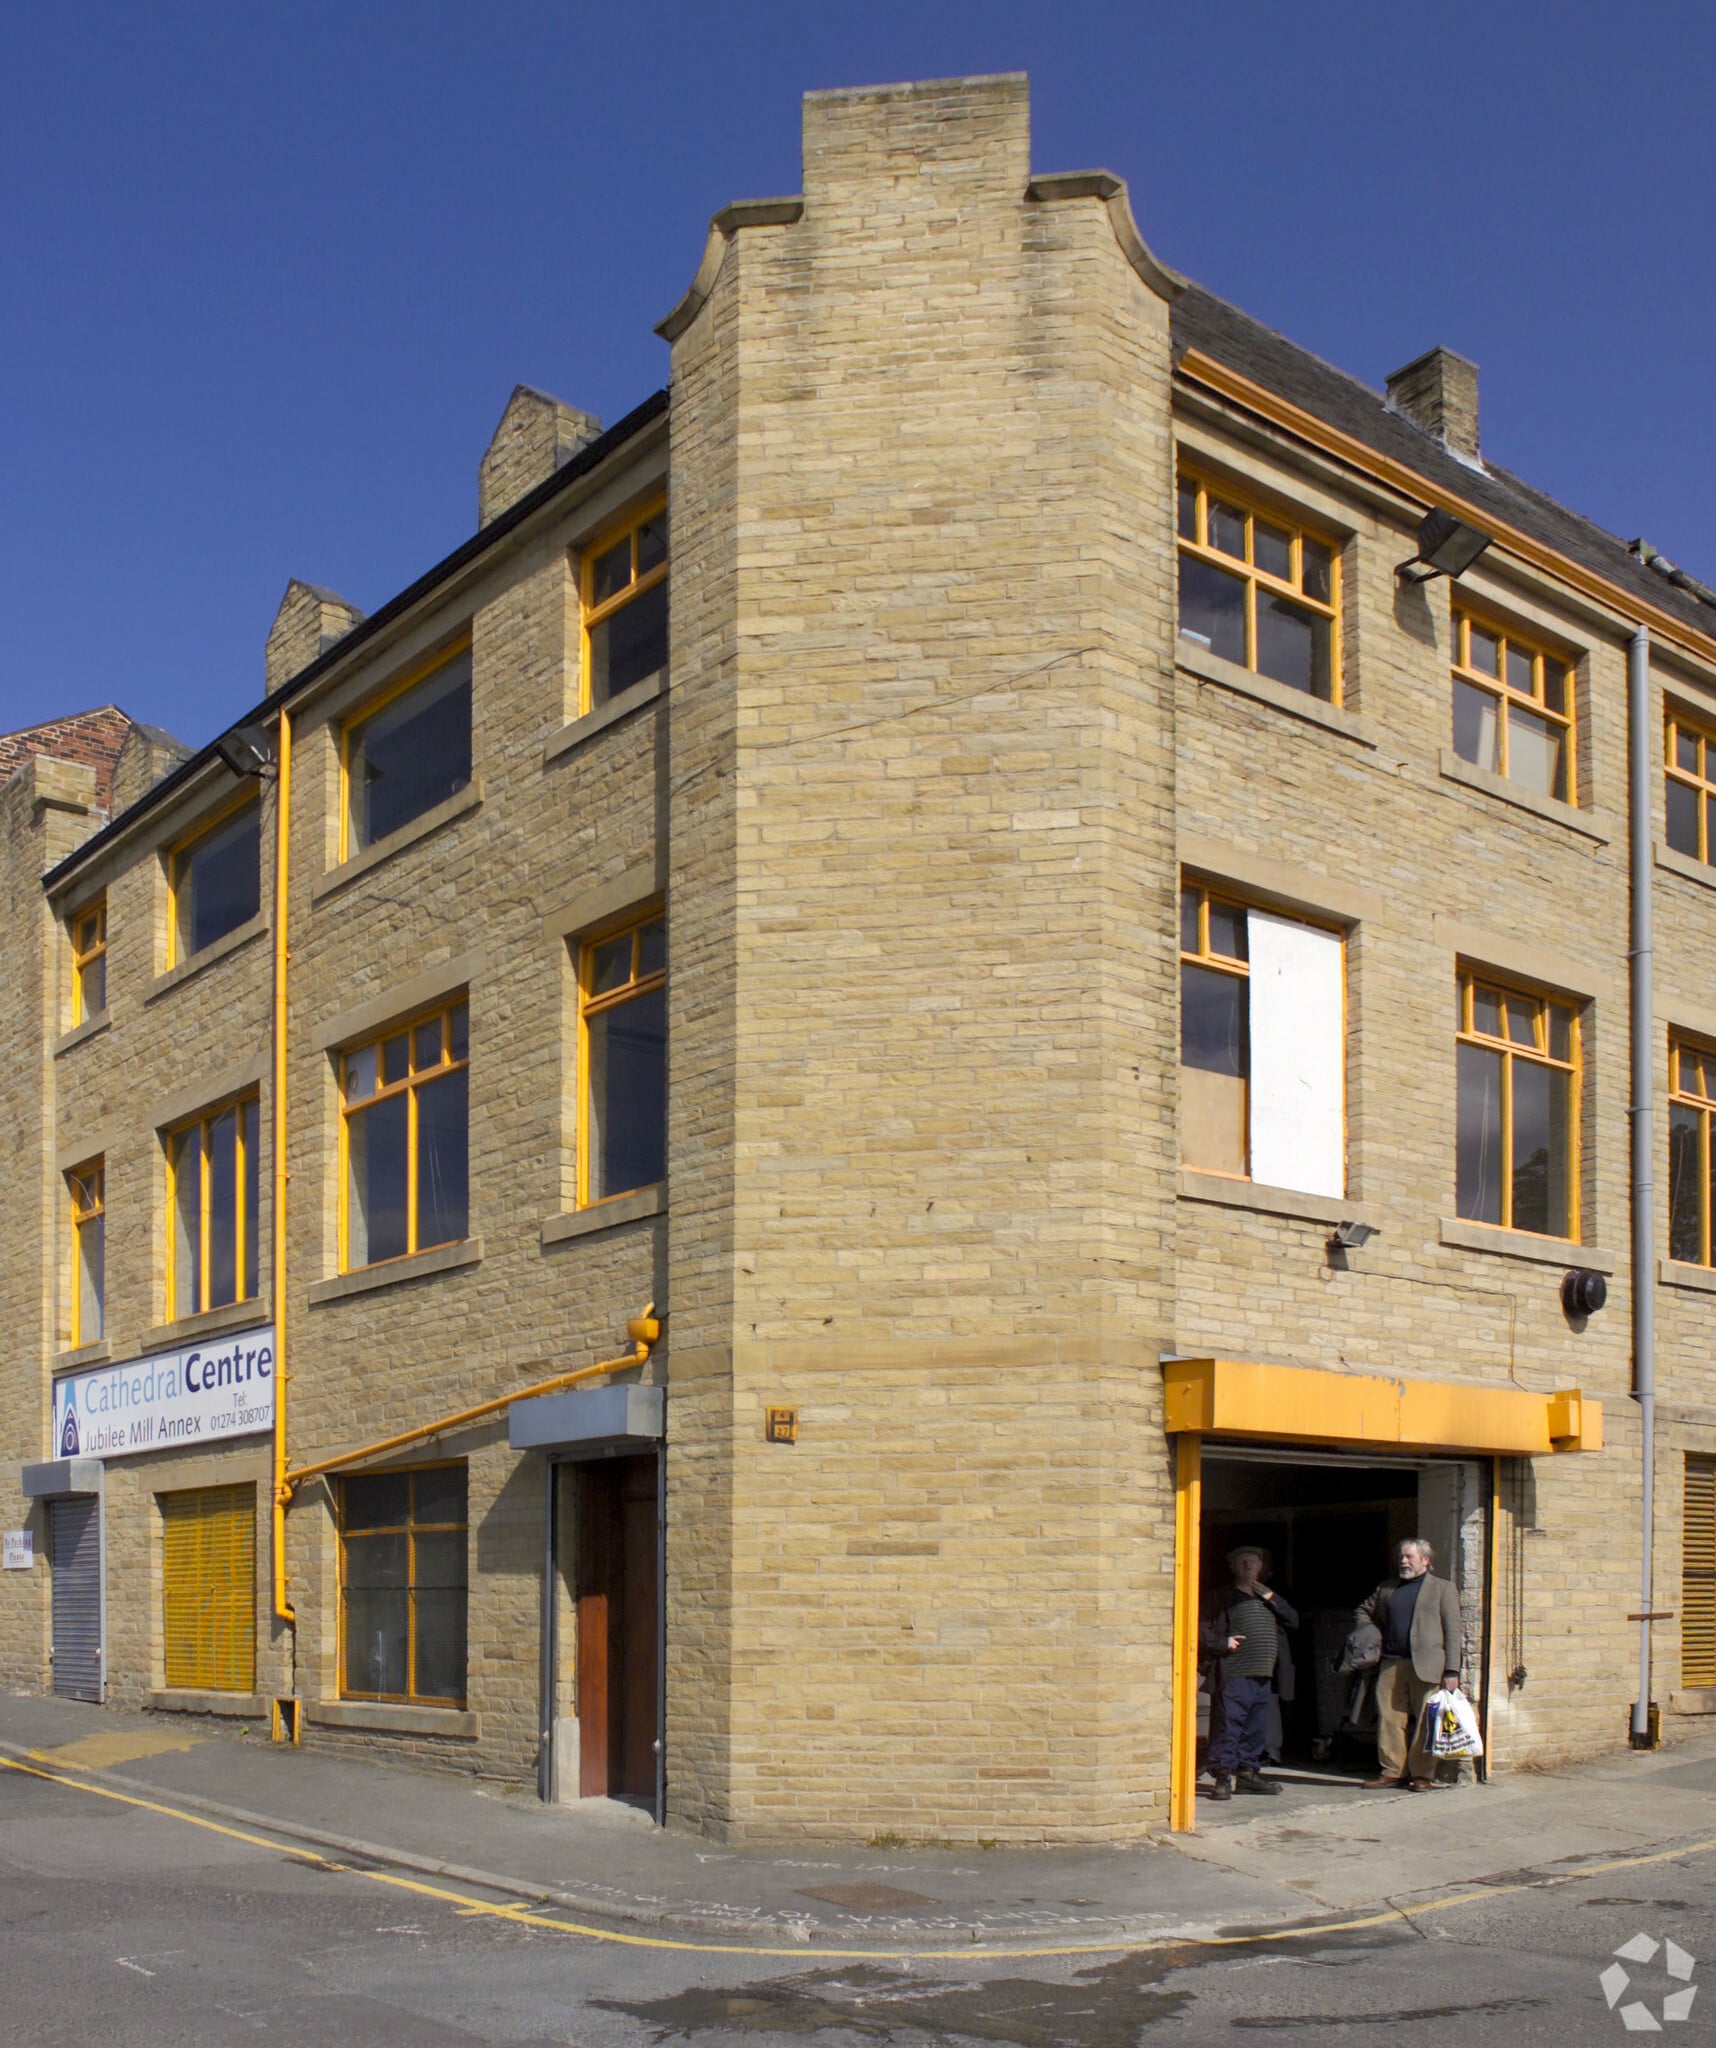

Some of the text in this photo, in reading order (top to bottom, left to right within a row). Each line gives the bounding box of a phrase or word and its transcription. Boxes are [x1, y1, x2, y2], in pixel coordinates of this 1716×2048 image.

[85, 1345, 272, 1414] Cathedral Centre
[85, 1415, 201, 1452] Jubilee Mill Annex
[210, 1411, 236, 1430] 01274
